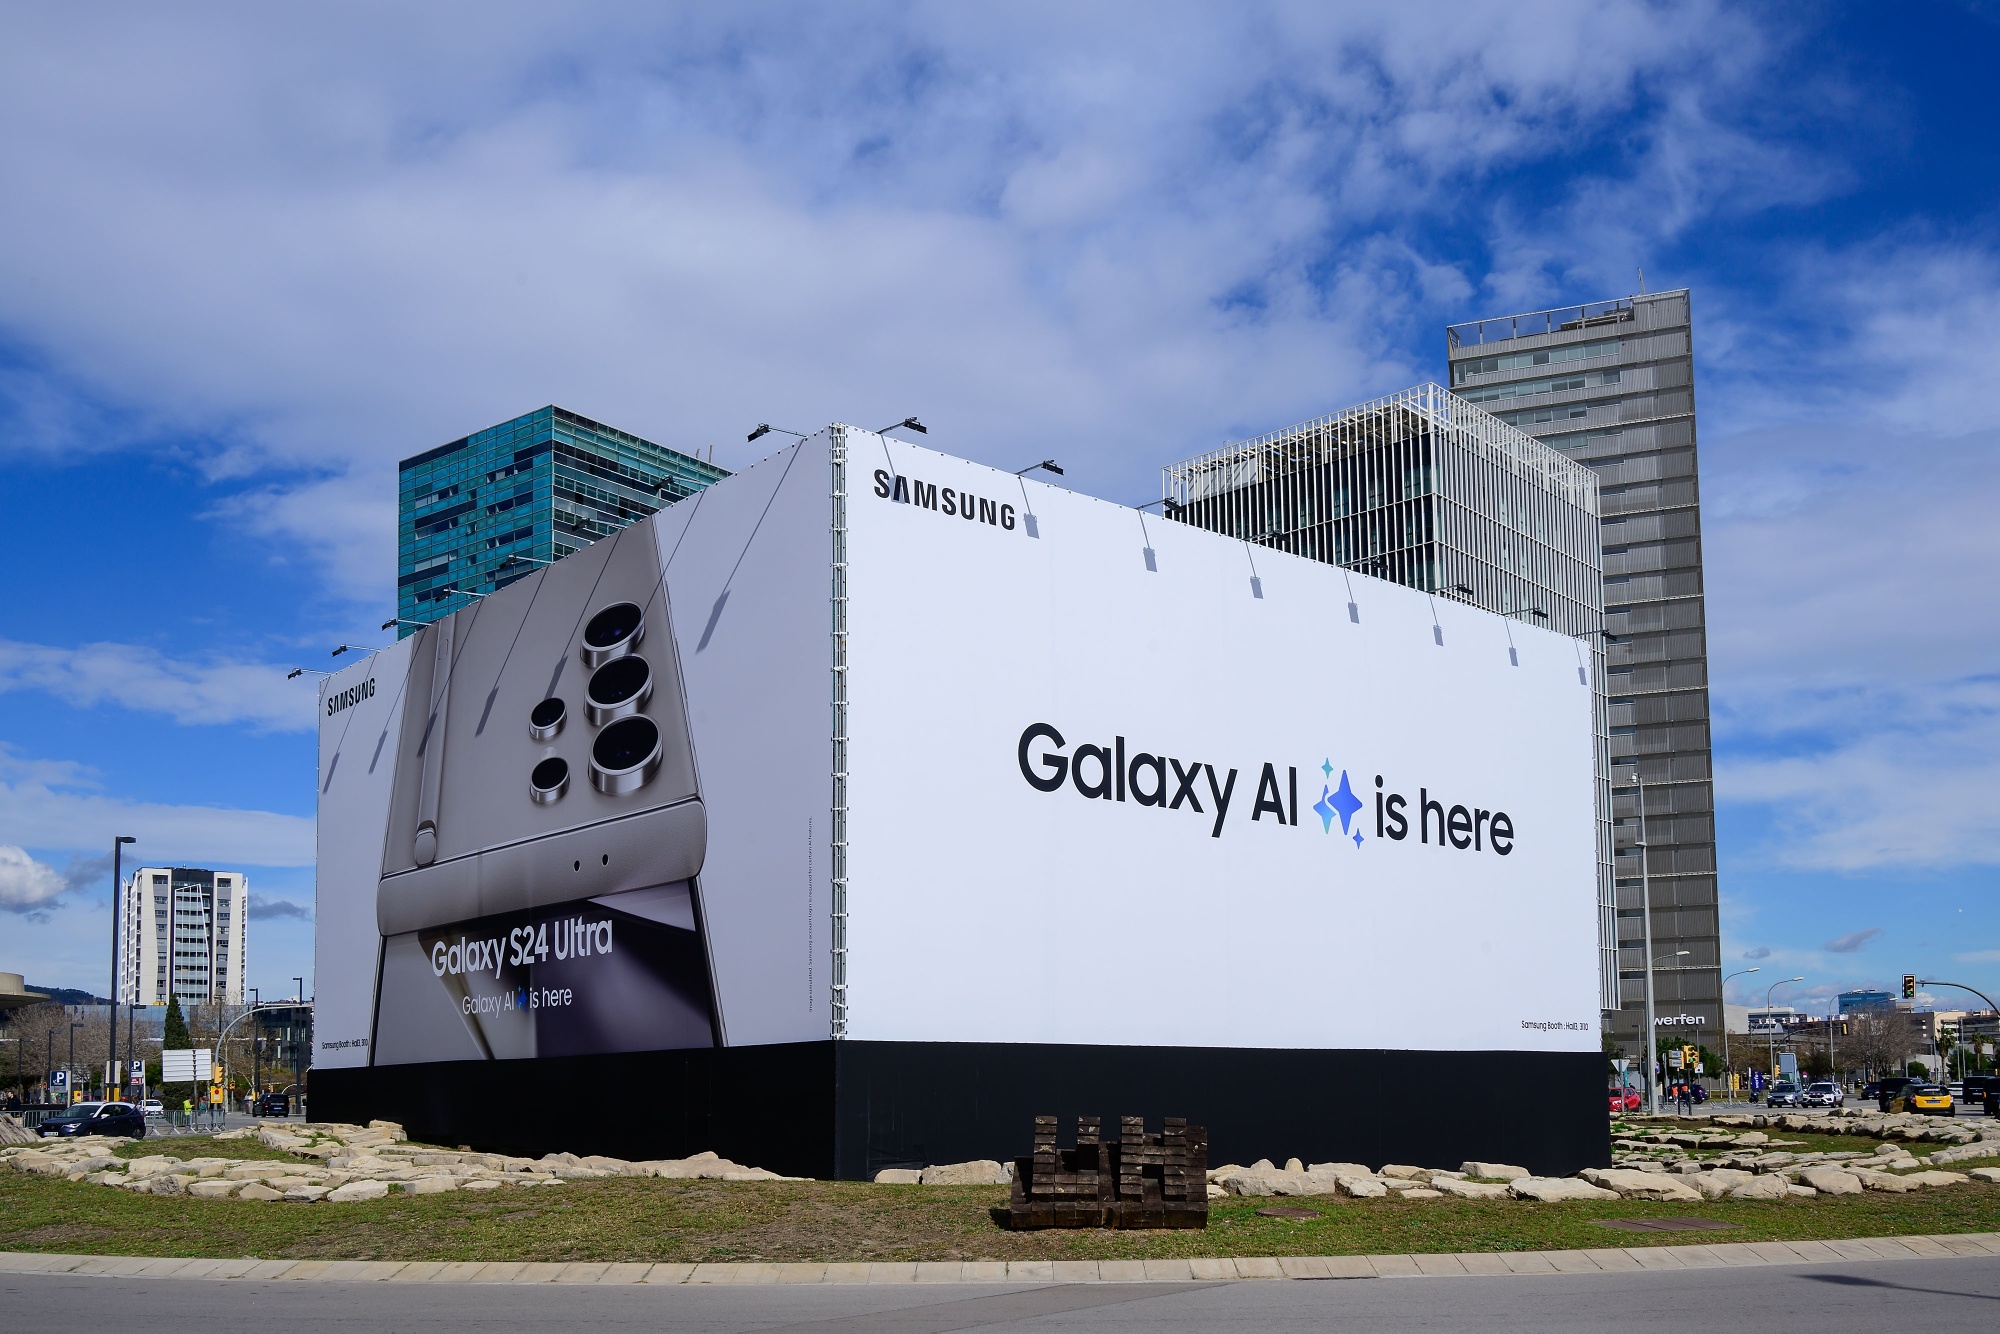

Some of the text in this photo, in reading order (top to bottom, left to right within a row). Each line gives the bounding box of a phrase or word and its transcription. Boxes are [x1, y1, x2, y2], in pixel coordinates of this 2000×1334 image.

[873, 469, 1015, 531] SAMSUNG
[328, 677, 375, 717] SAMSUNG
[1017, 722, 1514, 856] Galaxy AI is here
[432, 915, 613, 980] Galaxy S24 Ultra
[462, 986, 573, 1019] Galaxy AI is here
[1521, 1020, 1546, 1032] Samsung
[1547, 1021, 1563, 1030] Booth
[1653, 1013, 1705, 1026] werfen
[322, 1041, 339, 1051] Samsung
[339, 1040, 349, 1048] Booth
[56, 1071, 65, 1083] P
[133, 1061, 140, 1070] P
